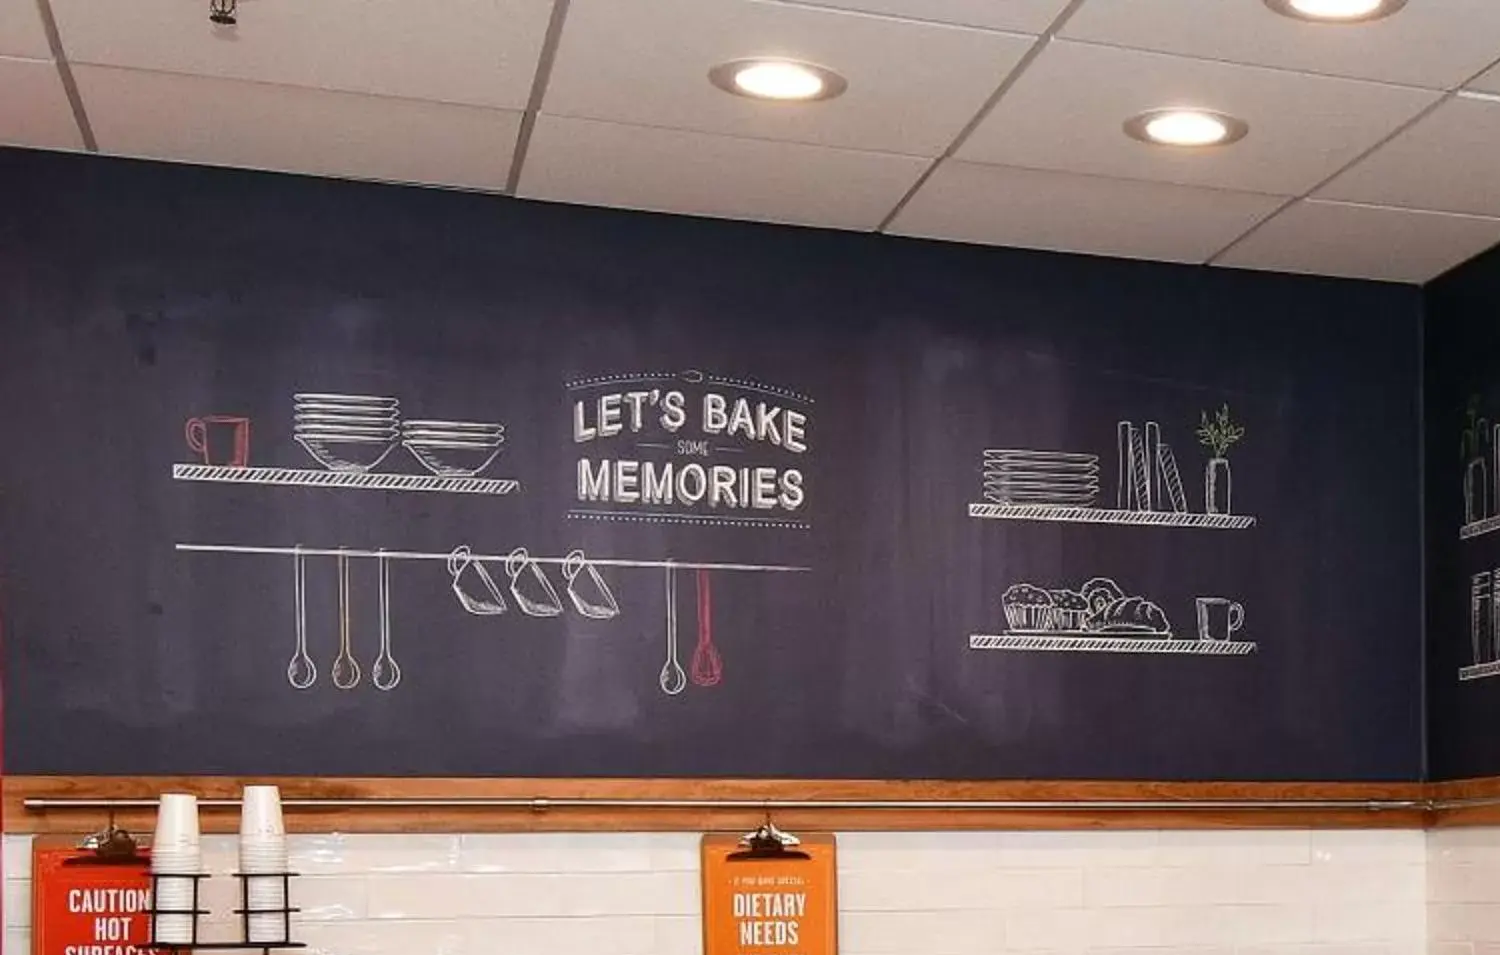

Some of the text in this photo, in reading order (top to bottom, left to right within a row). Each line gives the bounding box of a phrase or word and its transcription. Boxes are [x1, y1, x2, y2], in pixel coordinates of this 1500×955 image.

[574, 389, 807, 453] LET'S BAKE
[677, 439, 709, 457] SOME
[577, 458, 804, 511] MEMORIES
[69, 889, 151, 913] CAUTION
[733, 893, 806, 917] DIETARY
[95, 917, 132, 941] HOT
[740, 921, 799, 945] NEEDS
